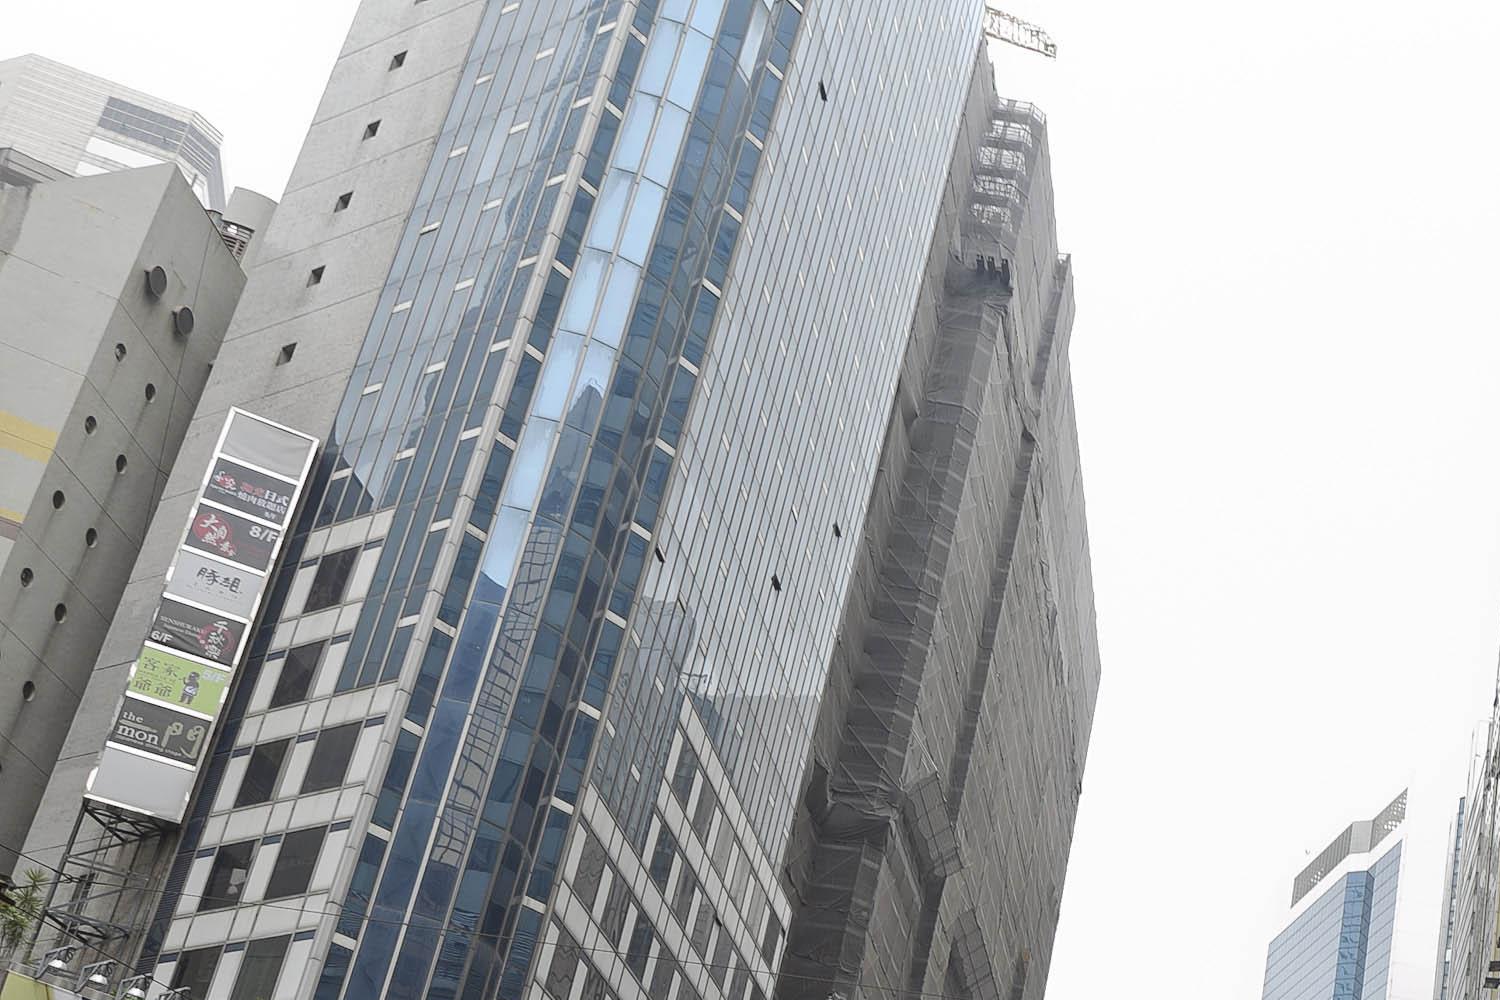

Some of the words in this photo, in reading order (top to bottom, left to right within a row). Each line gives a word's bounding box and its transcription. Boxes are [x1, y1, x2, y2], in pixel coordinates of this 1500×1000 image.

[249, 525, 279, 543] 8/F
[151, 630, 173, 643] 6/F
[122, 711, 145, 724] the
[117, 724, 161, 746] mon
